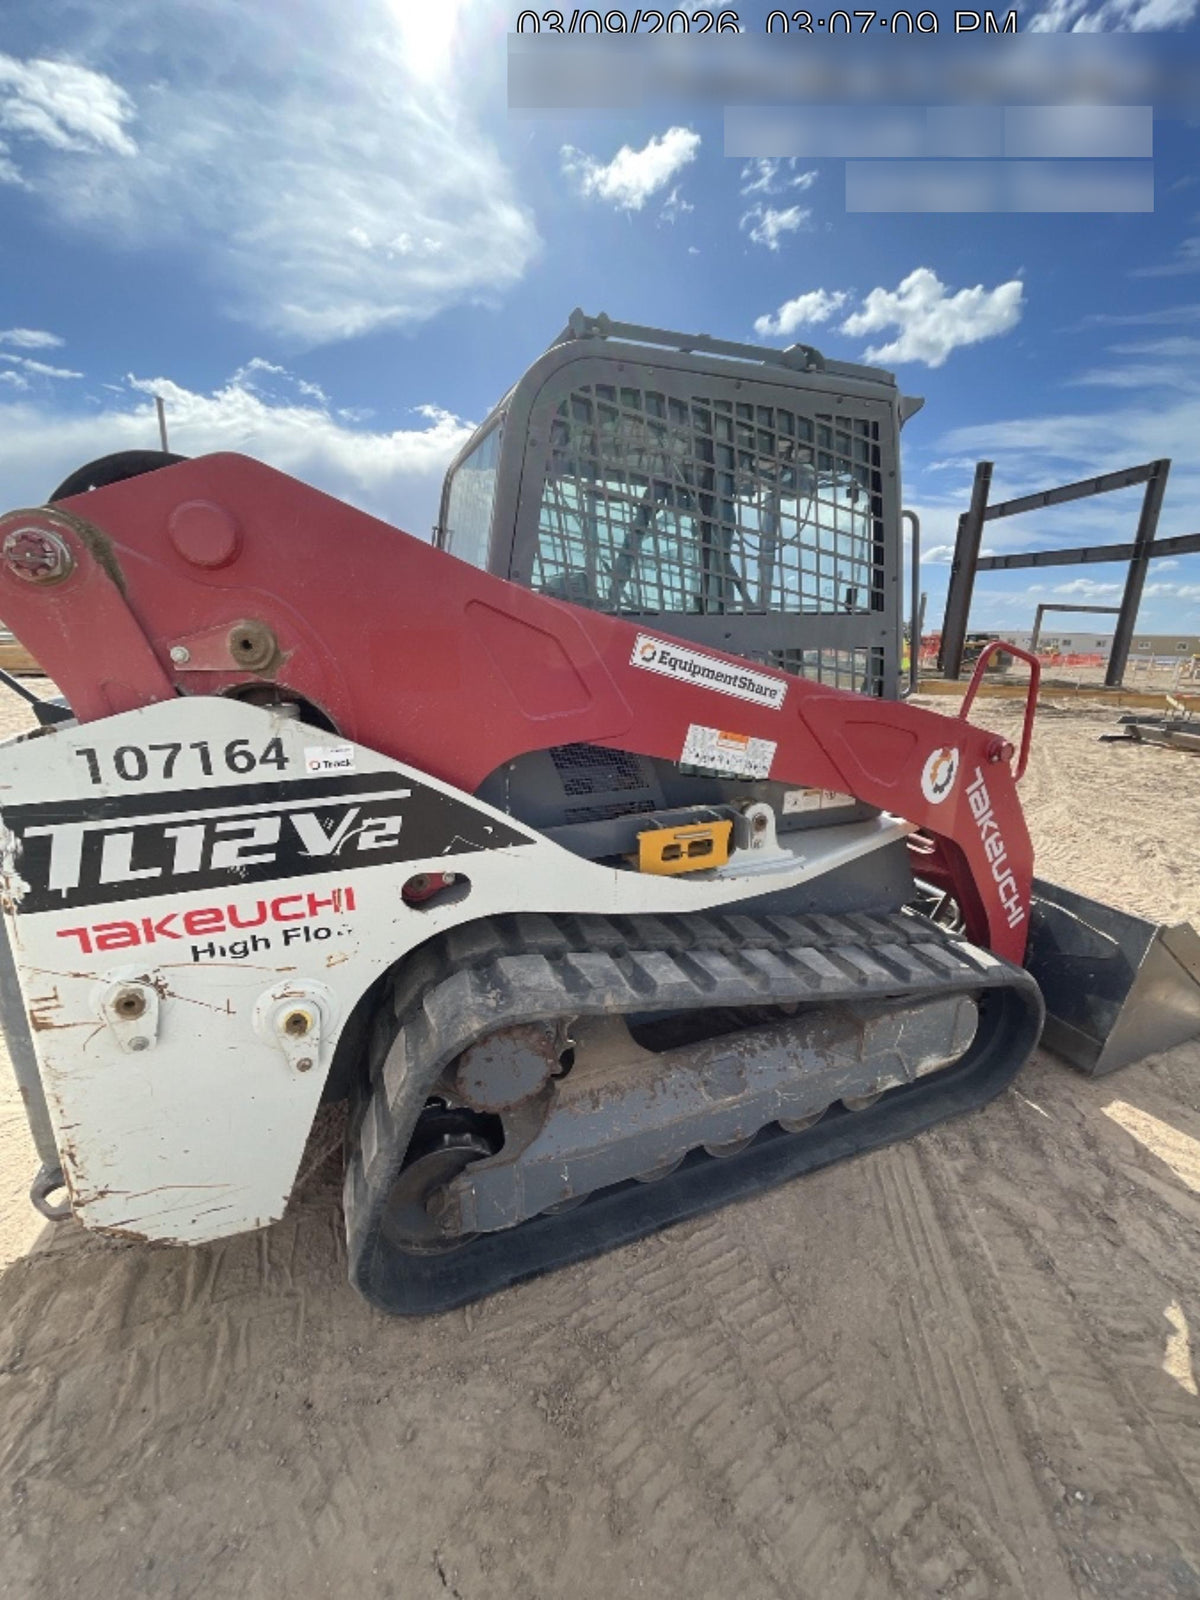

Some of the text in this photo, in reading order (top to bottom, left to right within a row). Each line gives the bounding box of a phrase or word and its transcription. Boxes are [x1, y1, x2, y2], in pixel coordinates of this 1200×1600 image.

[658, 650, 778, 699] EquipmentShare
[75, 737, 290, 784] 107164
[322, 758, 352, 769] Track
[190, 925, 353, 962] High Flo
